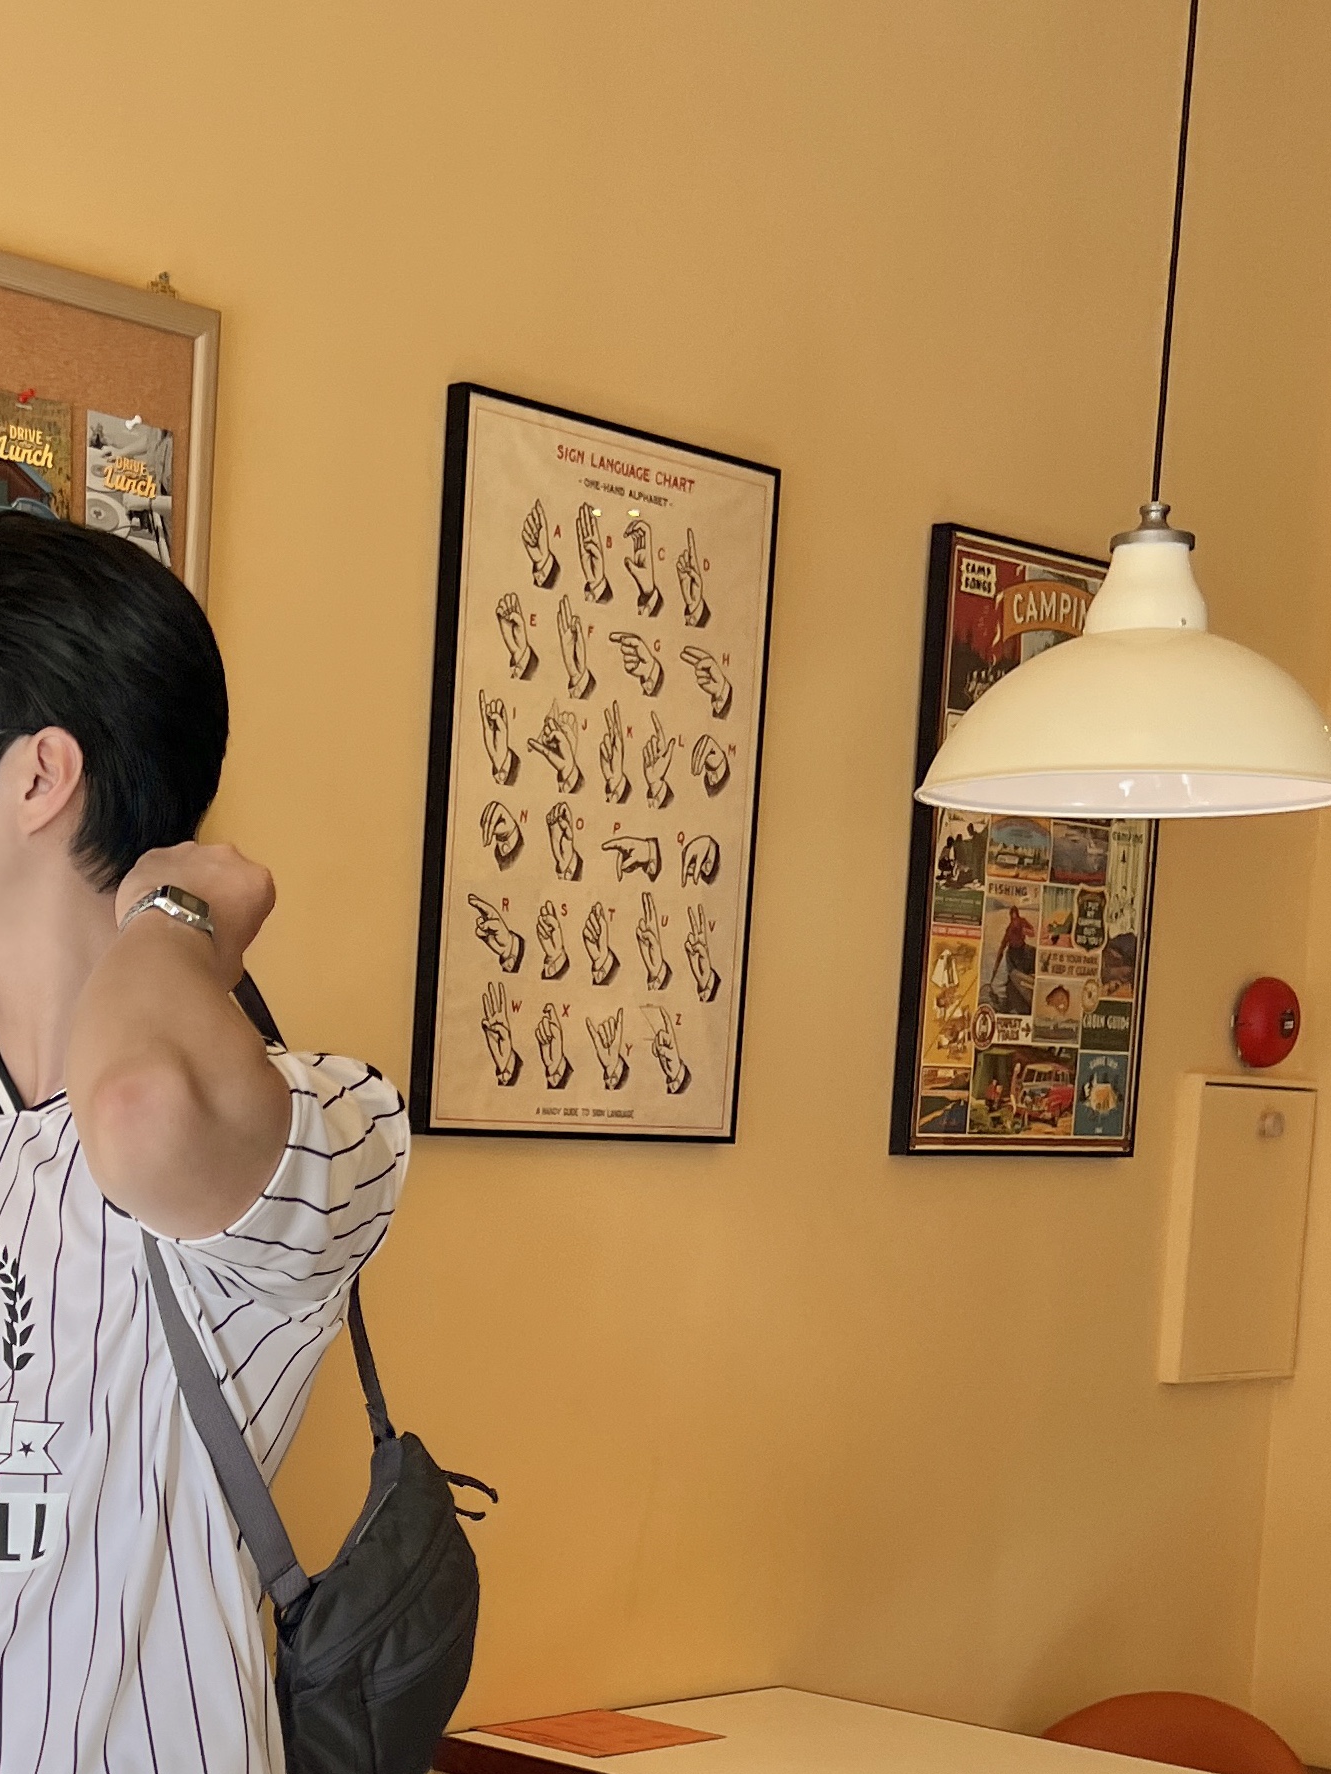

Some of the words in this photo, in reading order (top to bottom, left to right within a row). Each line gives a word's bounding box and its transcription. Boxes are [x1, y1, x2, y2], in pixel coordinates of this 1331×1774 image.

[9, 425, 43, 445] DRIVE
[115, 456, 147, 475] DRIVE
[557, 445, 584, 465] SIGN
[590, 453, 650, 483] LANGUAGE
[655, 471, 695, 494] CHART
[103, 466, 156, 499] Lunch
[553, 525, 561, 538] A
[606, 536, 612, 548] B
[658, 548, 665, 561] C
[704, 558, 710, 571] D
[966, 562, 992, 576] CAMP
[530, 614, 536, 627] E
[588, 626, 593, 638] F
[654, 639, 660, 651] G
[722, 653, 729, 666] H
[582, 719, 587, 731] J
[627, 726, 633, 738] K
[679, 735, 684, 747] L
[729, 744, 736, 756] M
[520, 810, 527, 823] N
[613, 822, 620, 835] P
[988, 883, 1027, 897] FISHING
[502, 898, 509, 911] R
[562, 904, 567, 917] S
[608, 909, 616, 923] T
[662, 915, 668, 928] U
[708, 920, 715, 933] V
[511, 1000, 522, 1013] W
[562, 1004, 570, 1017] X
[675, 1014, 682, 1026] Z
[626, 1043, 633, 1056] Y
